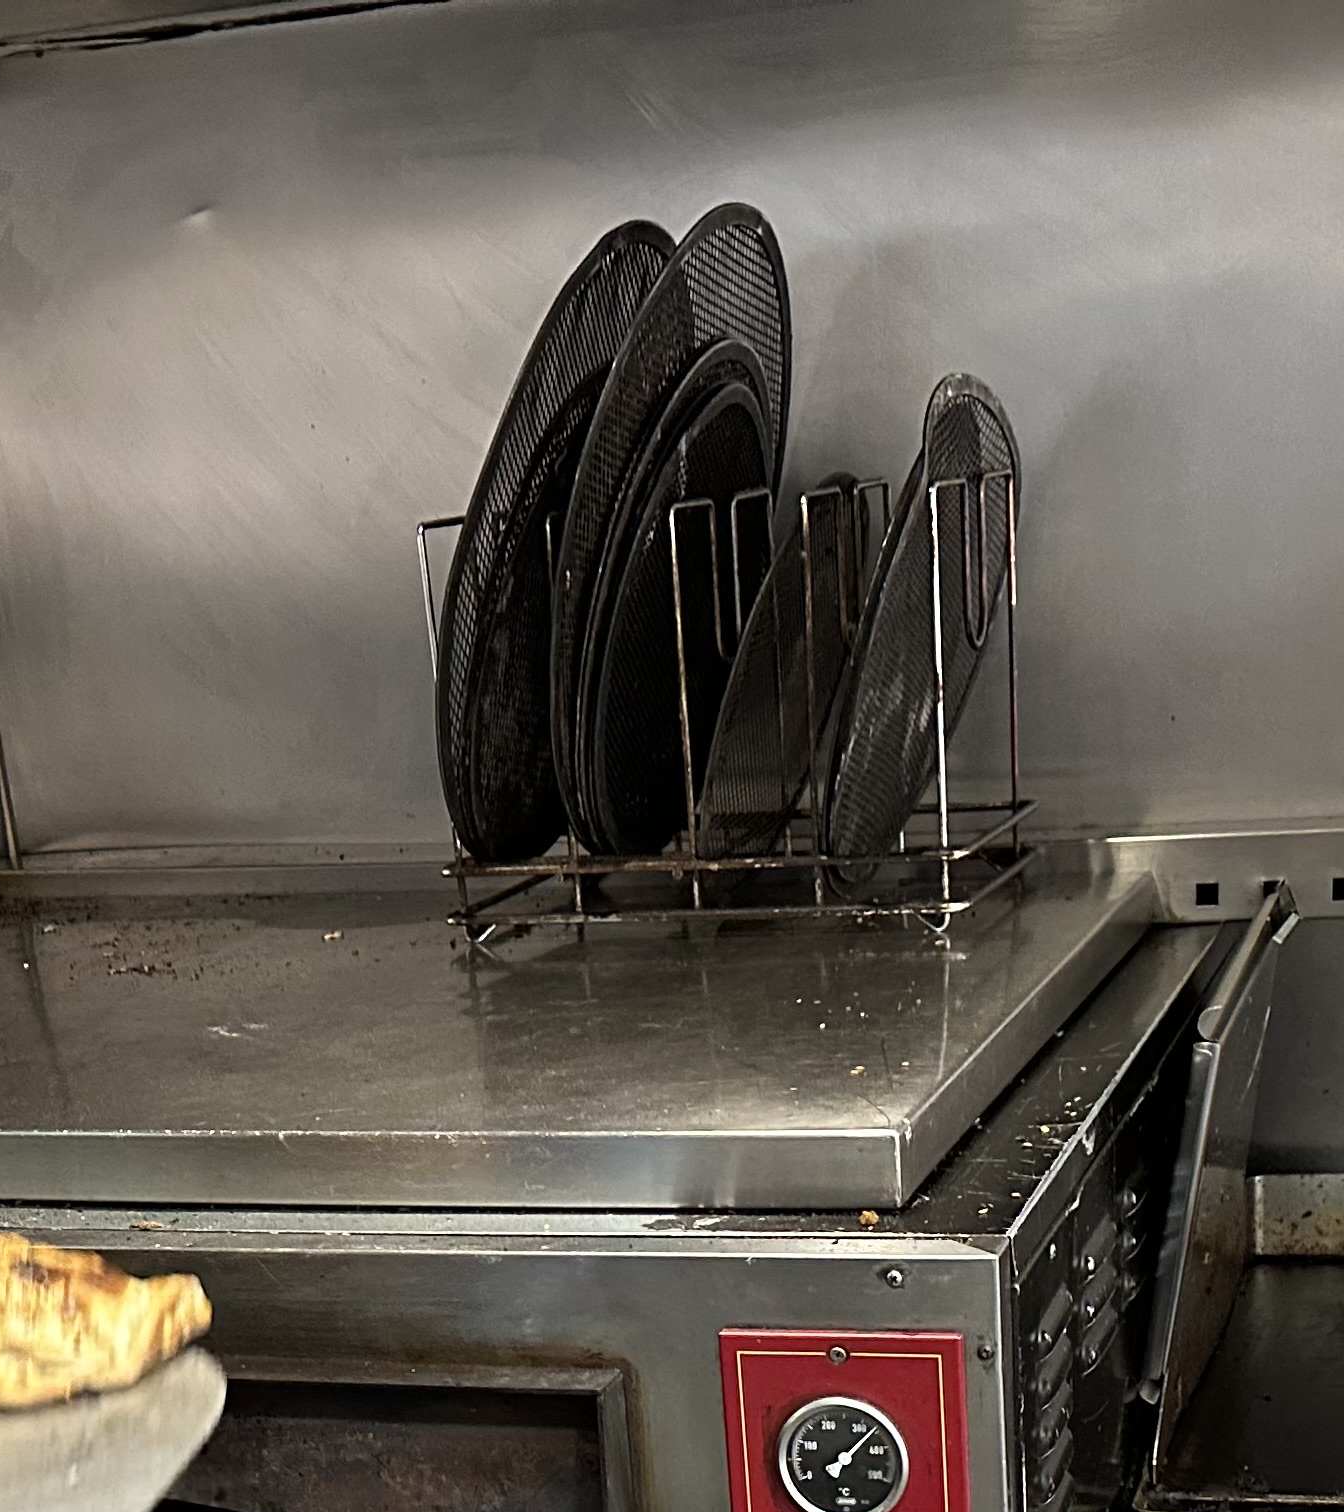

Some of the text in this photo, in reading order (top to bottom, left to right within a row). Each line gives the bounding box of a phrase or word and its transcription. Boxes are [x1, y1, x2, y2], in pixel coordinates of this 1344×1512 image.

[821, 1420, 836, 1431] 200
[852, 1423, 867, 1433] 300
[803, 1440, 818, 1451] 100
[869, 1446, 884, 1455] 400
